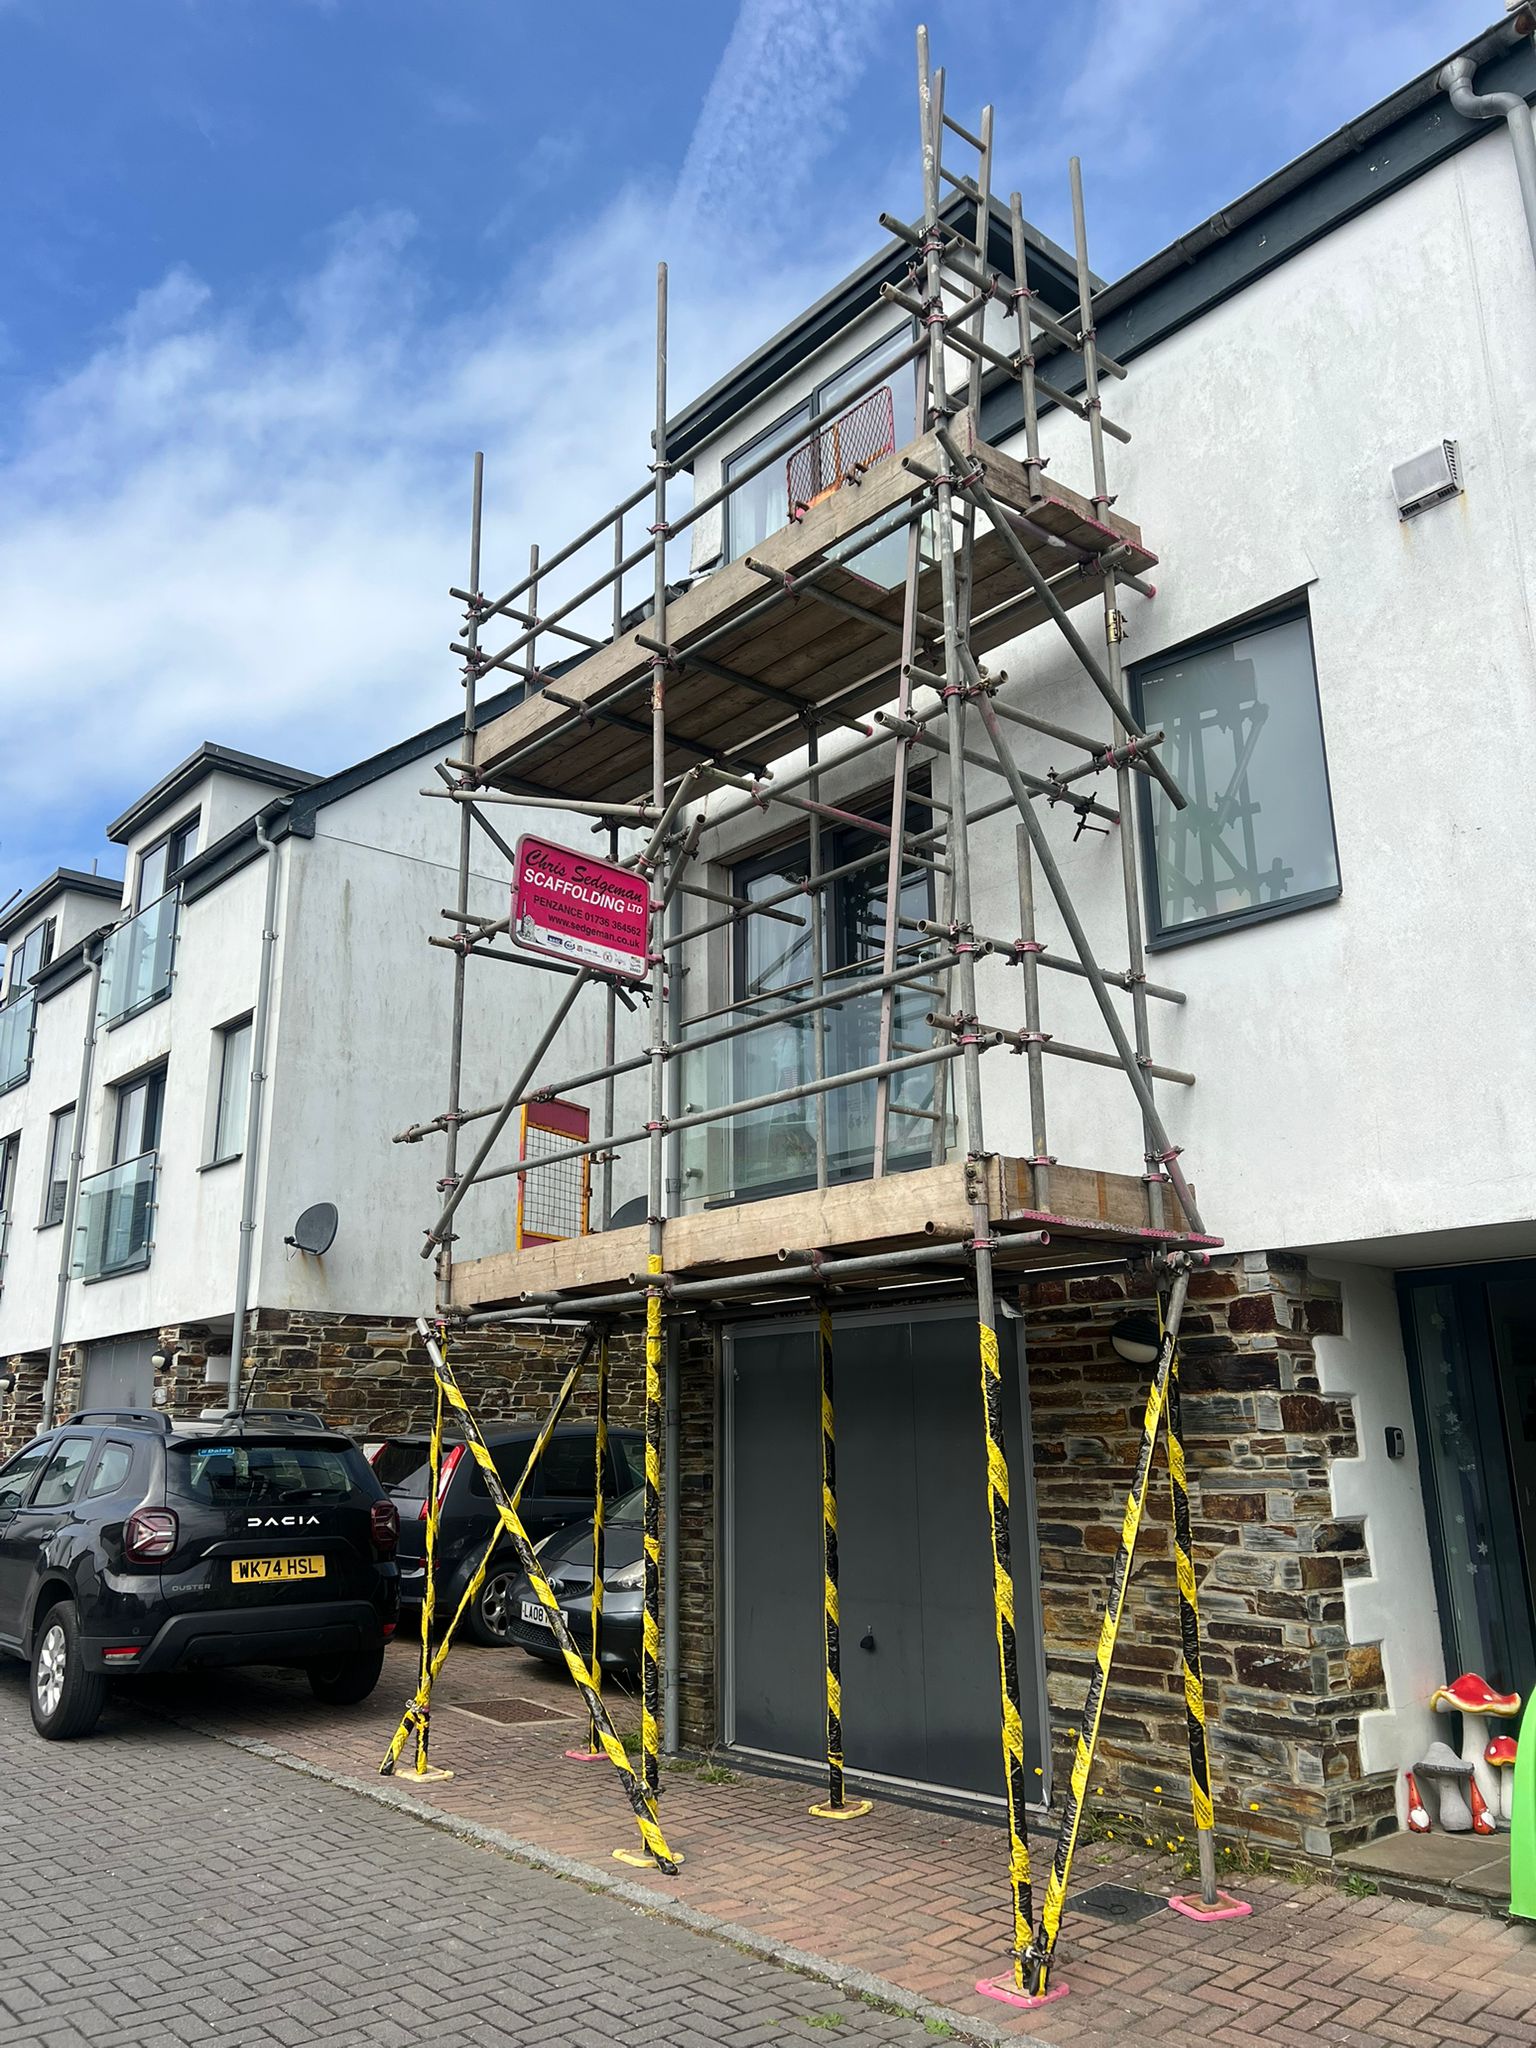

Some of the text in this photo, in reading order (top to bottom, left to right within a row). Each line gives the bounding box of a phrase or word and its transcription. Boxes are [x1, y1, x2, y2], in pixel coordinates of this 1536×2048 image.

[525, 849, 644, 903] Chris Sedgeman
[523, 868, 644, 915] SCAFFOLDING LTD
[533, 894, 583, 918] PENZANCE
[548, 913, 640, 949] www.sedgeman.co.uk
[247, 1515, 320, 1527] DACIA
[239, 1558, 318, 1579] WK74 HSL
[172, 1583, 211, 1591] DUSTER
[524, 1603, 544, 1622] LA08
